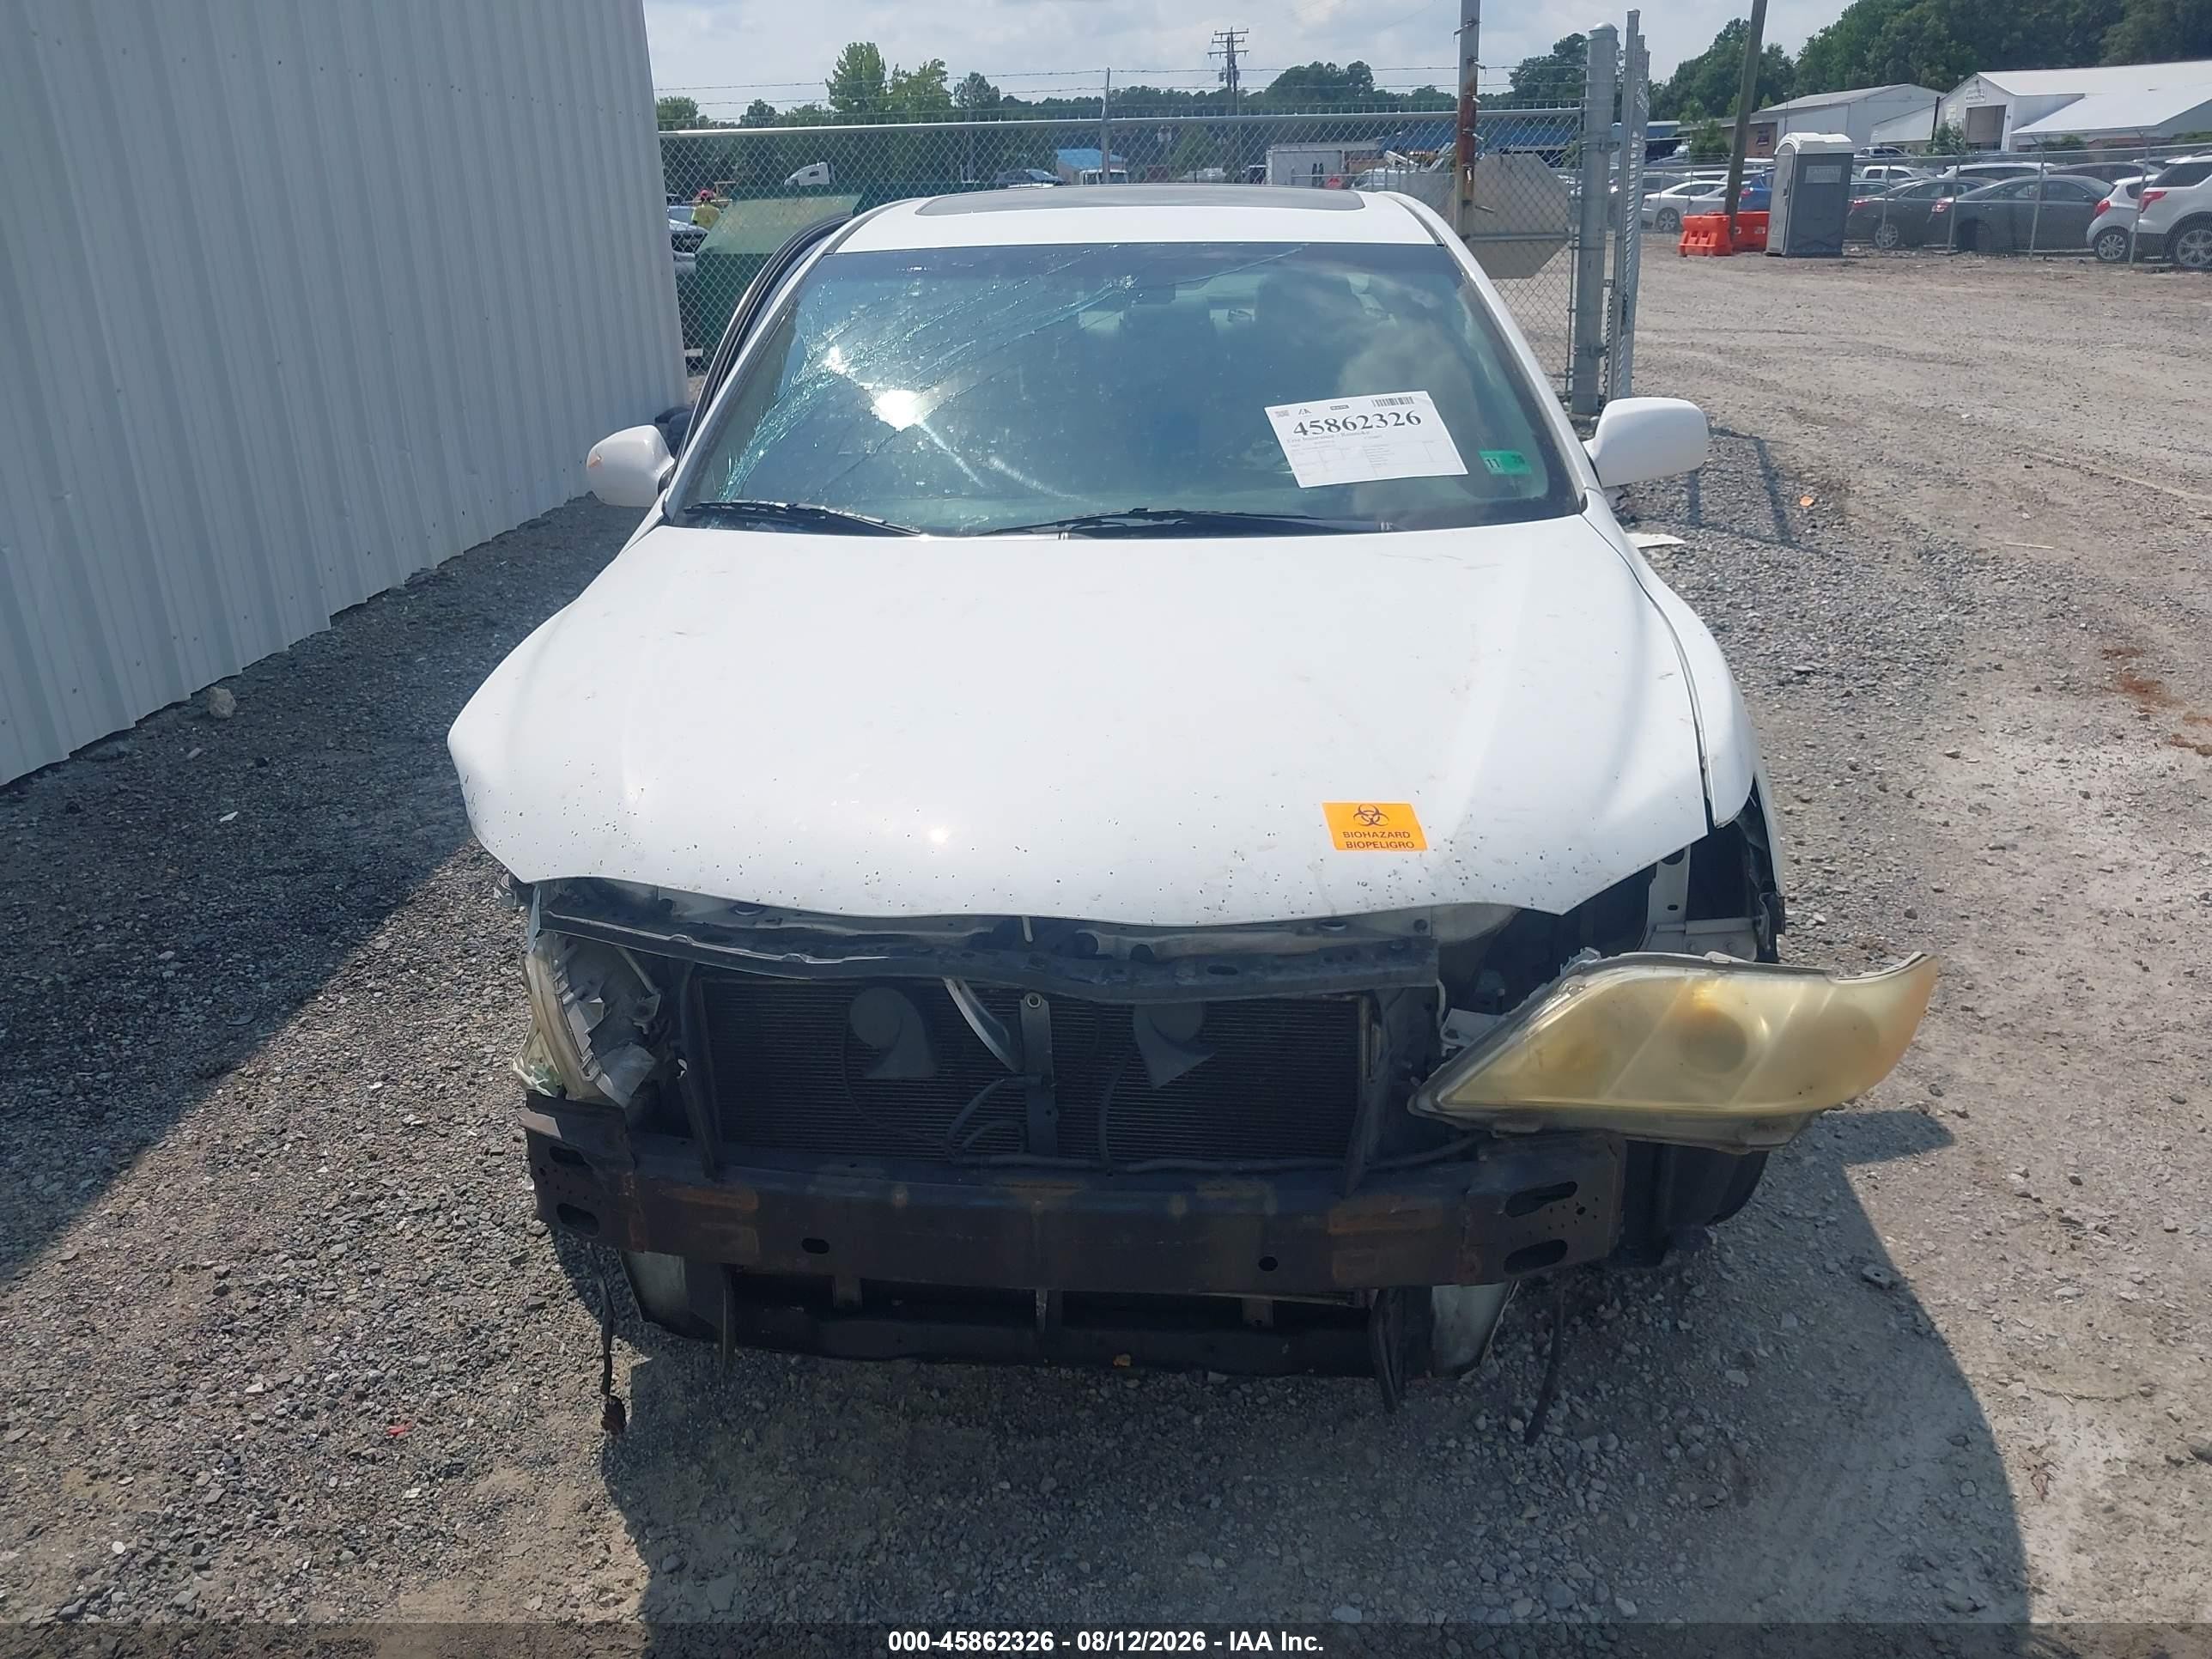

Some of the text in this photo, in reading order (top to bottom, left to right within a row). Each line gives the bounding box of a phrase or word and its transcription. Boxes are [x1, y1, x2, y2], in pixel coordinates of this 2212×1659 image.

[1293, 410, 1422, 436] 45862326
[1486, 459, 1500, 468] 11
[1346, 841, 1415, 849] BIOPELIGRO
